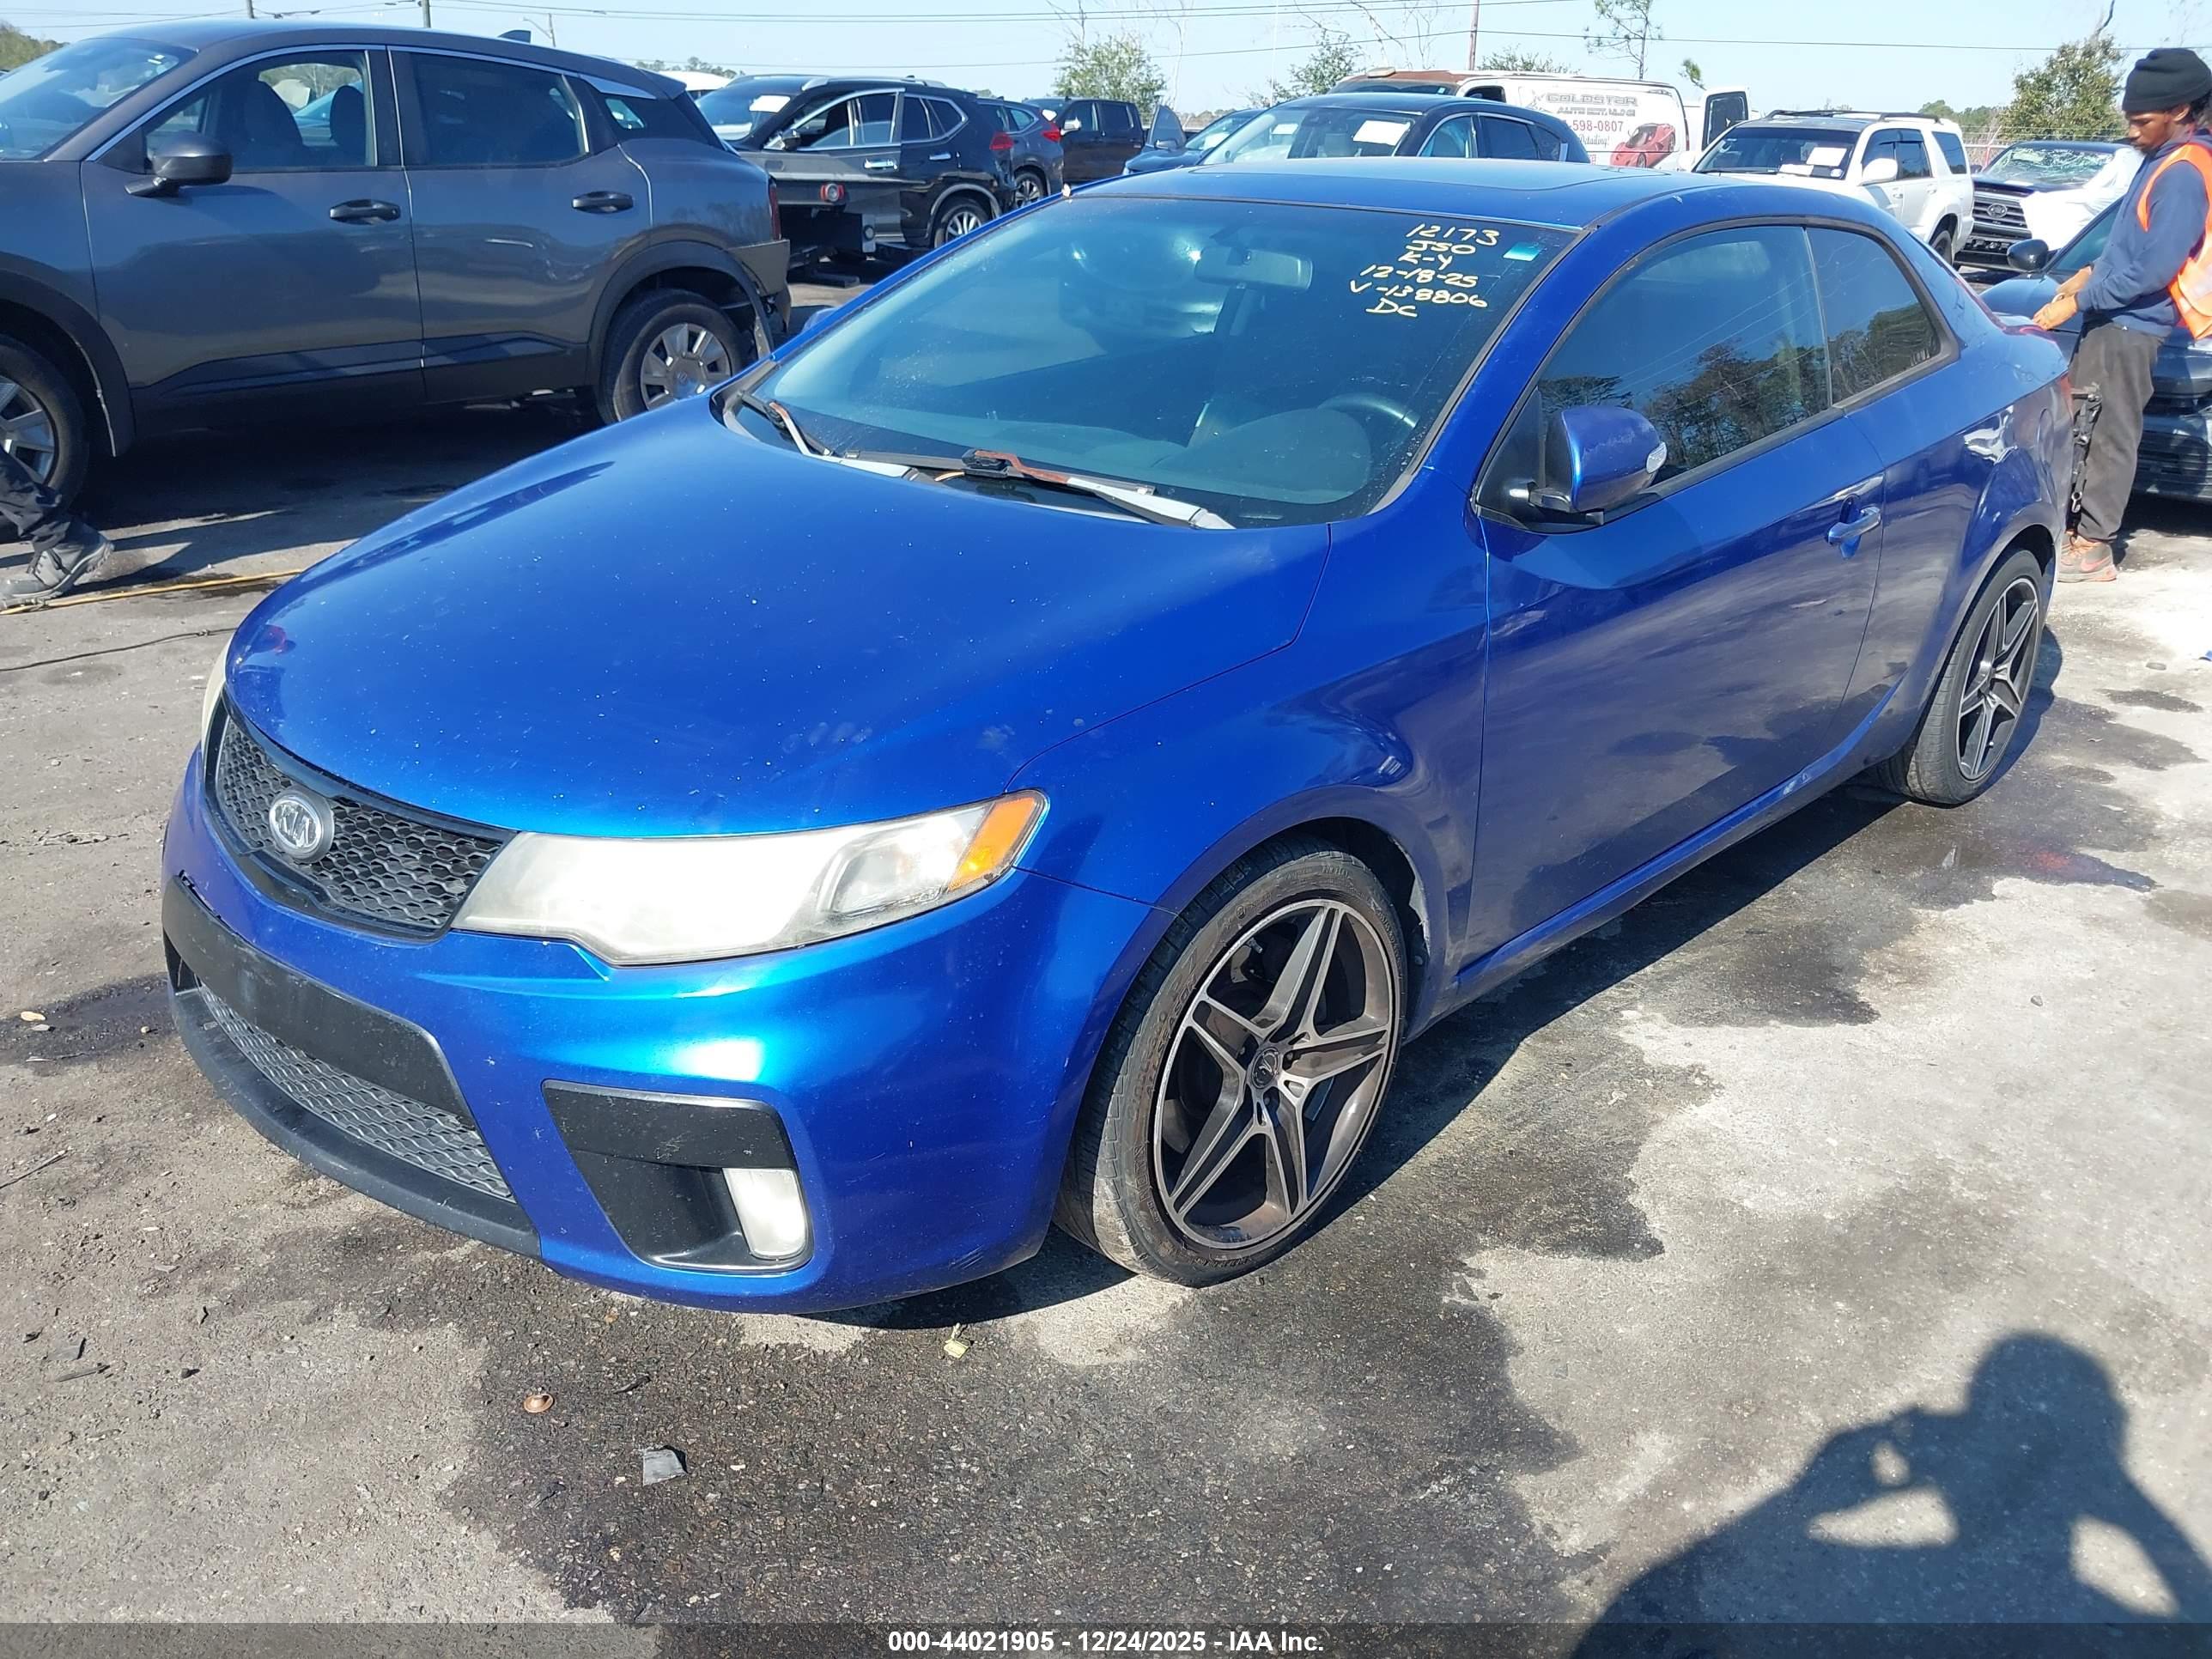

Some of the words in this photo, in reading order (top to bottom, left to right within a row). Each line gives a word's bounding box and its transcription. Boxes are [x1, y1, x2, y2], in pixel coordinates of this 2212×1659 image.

[1406, 223, 1500, 246] 12173
[1406, 239, 1476, 256] JSO
[1359, 264, 1479, 289] 12-18-25
[1365, 297, 1418, 318] DC
